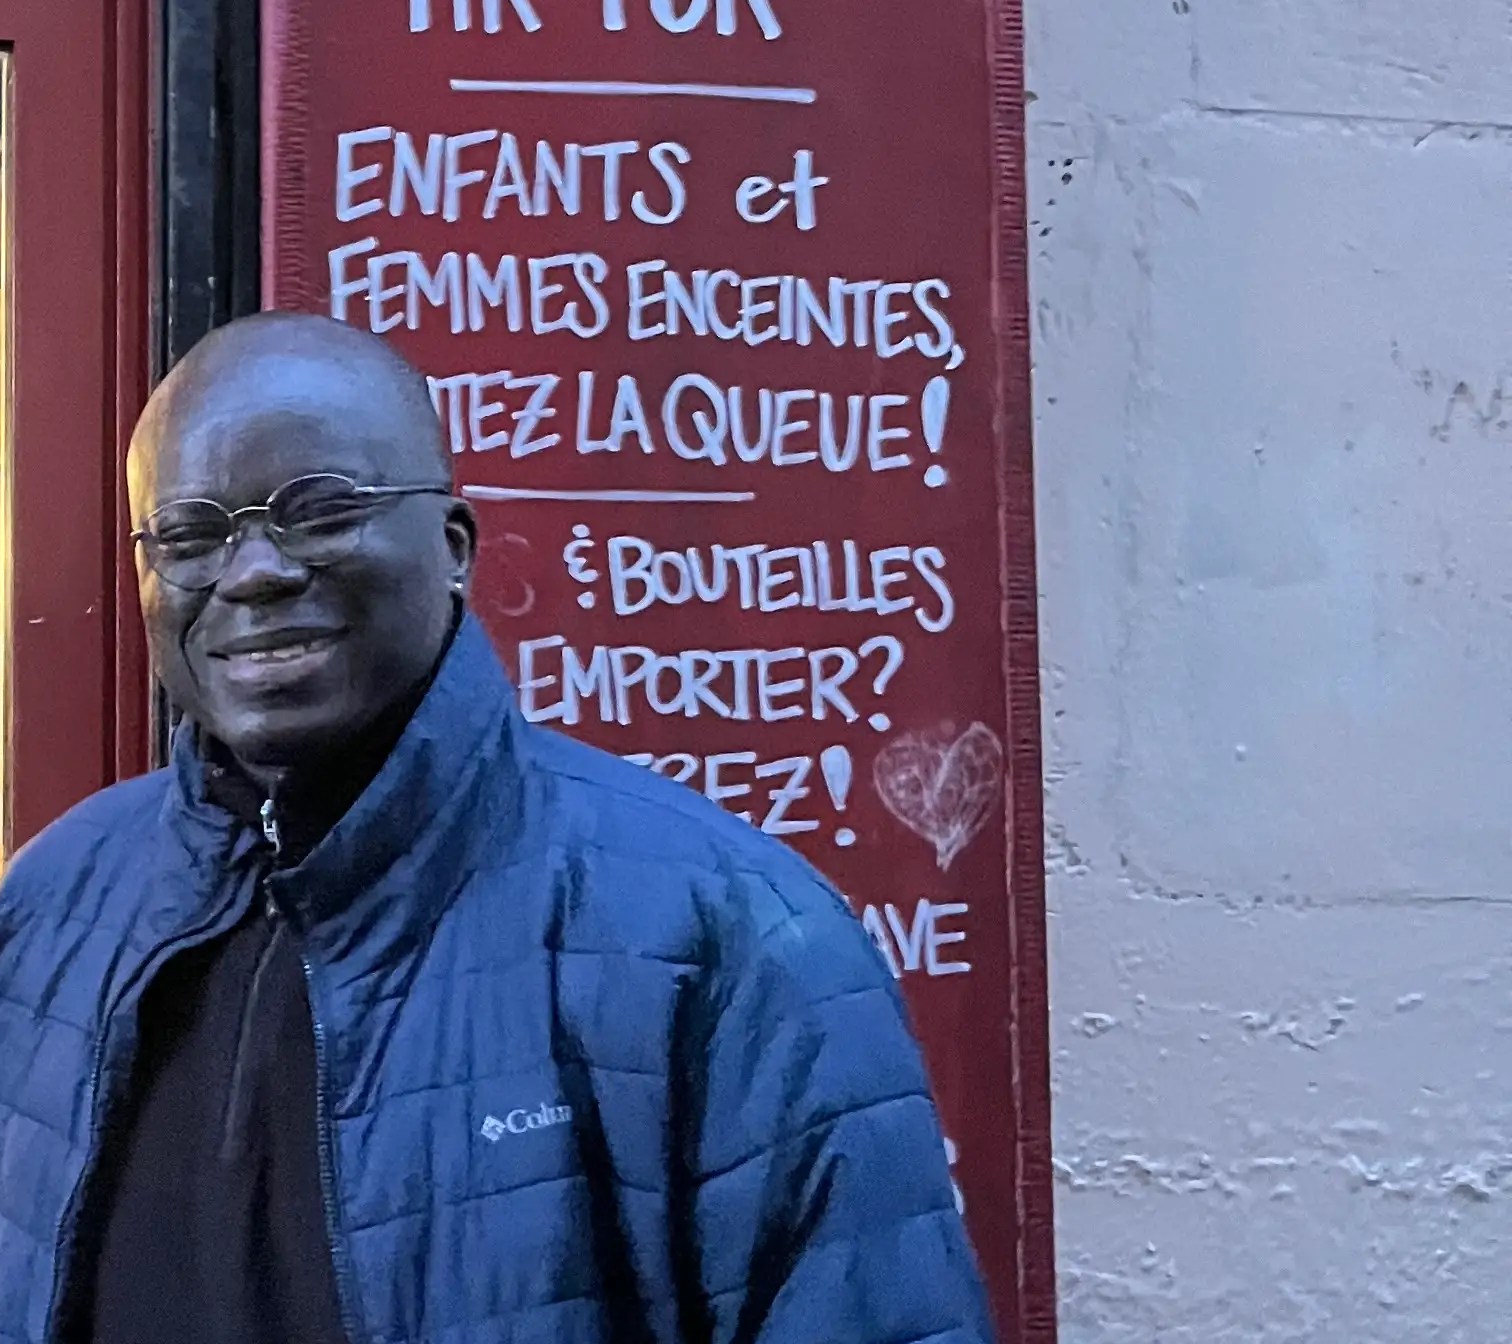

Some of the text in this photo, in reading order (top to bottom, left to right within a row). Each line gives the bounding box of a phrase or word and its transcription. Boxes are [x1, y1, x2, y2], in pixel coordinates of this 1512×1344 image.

[336, 126, 829, 231] ENFANTS et
[328, 236, 965, 370] FEMMES ENCEINTES,
[576, 370, 655, 454] LA
[662, 373, 951, 488] QUEUE!
[608, 535, 955, 633] BOUTEILLES
[519, 635, 904, 732] EMPORTER?
[842, 894, 972, 980] AVE
